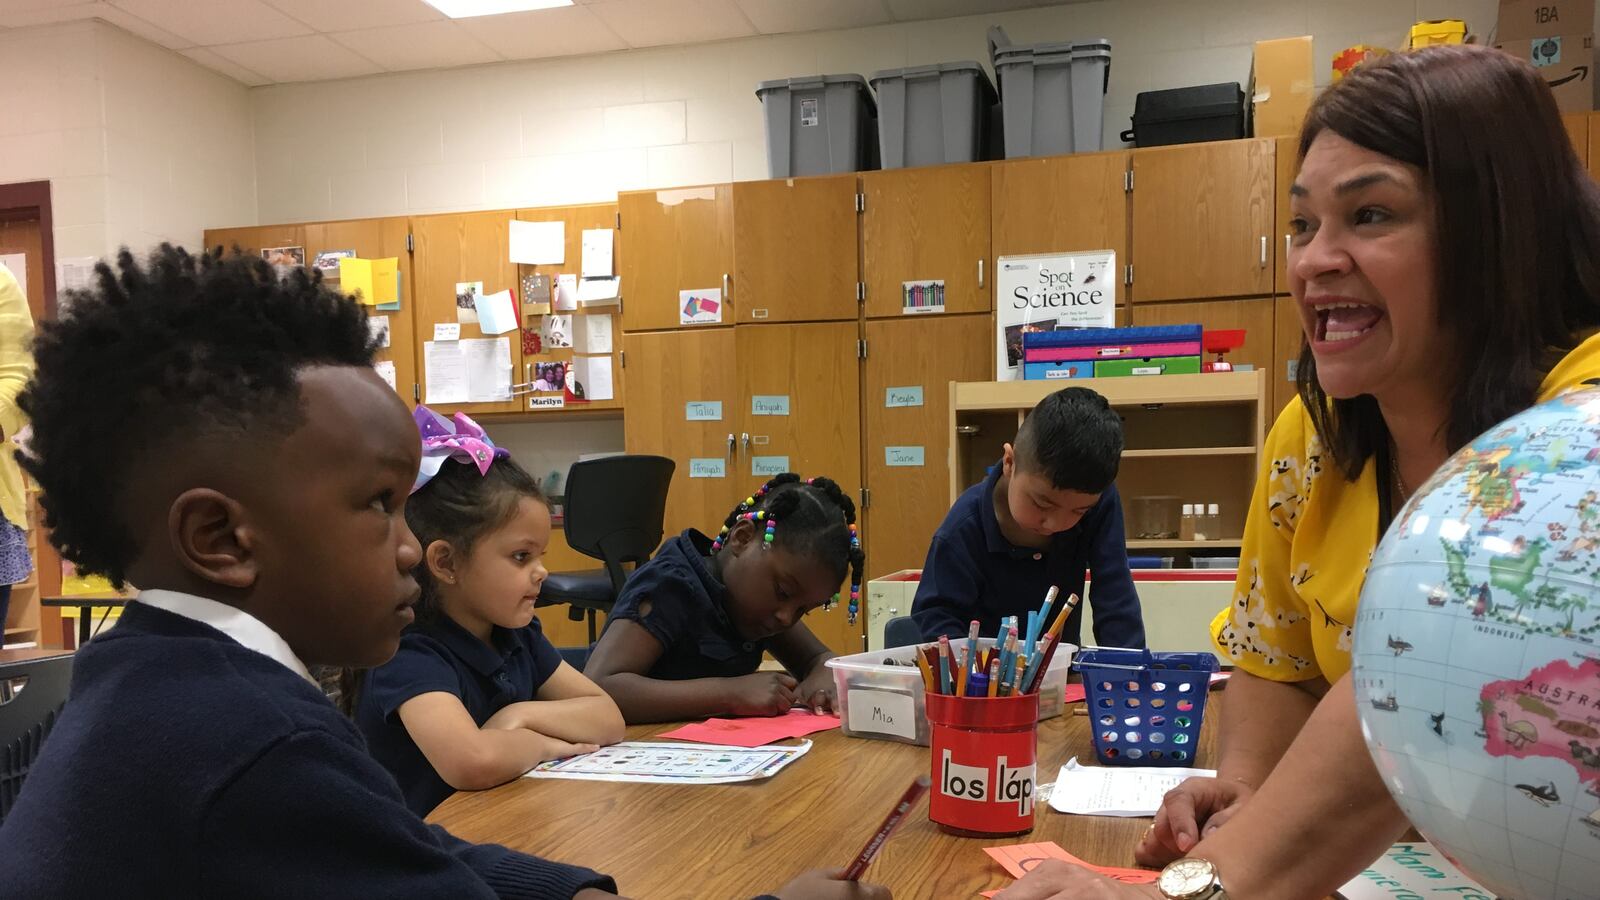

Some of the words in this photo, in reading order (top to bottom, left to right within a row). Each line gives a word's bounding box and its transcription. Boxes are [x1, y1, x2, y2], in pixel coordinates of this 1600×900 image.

[1534, 6, 1559, 23] 1BA
[1039, 268, 1073, 287] Spot
[1013, 286, 1103, 309] Science
[531, 398, 562, 406] Marilyn
[690, 404, 715, 416] Talia
[890, 450, 915, 463] Jane
[1474, 624, 1526, 641] INDONESIA
[872, 706, 894, 725] Mia
[943, 757, 985, 799] los
[998, 763, 1032, 815] láp
